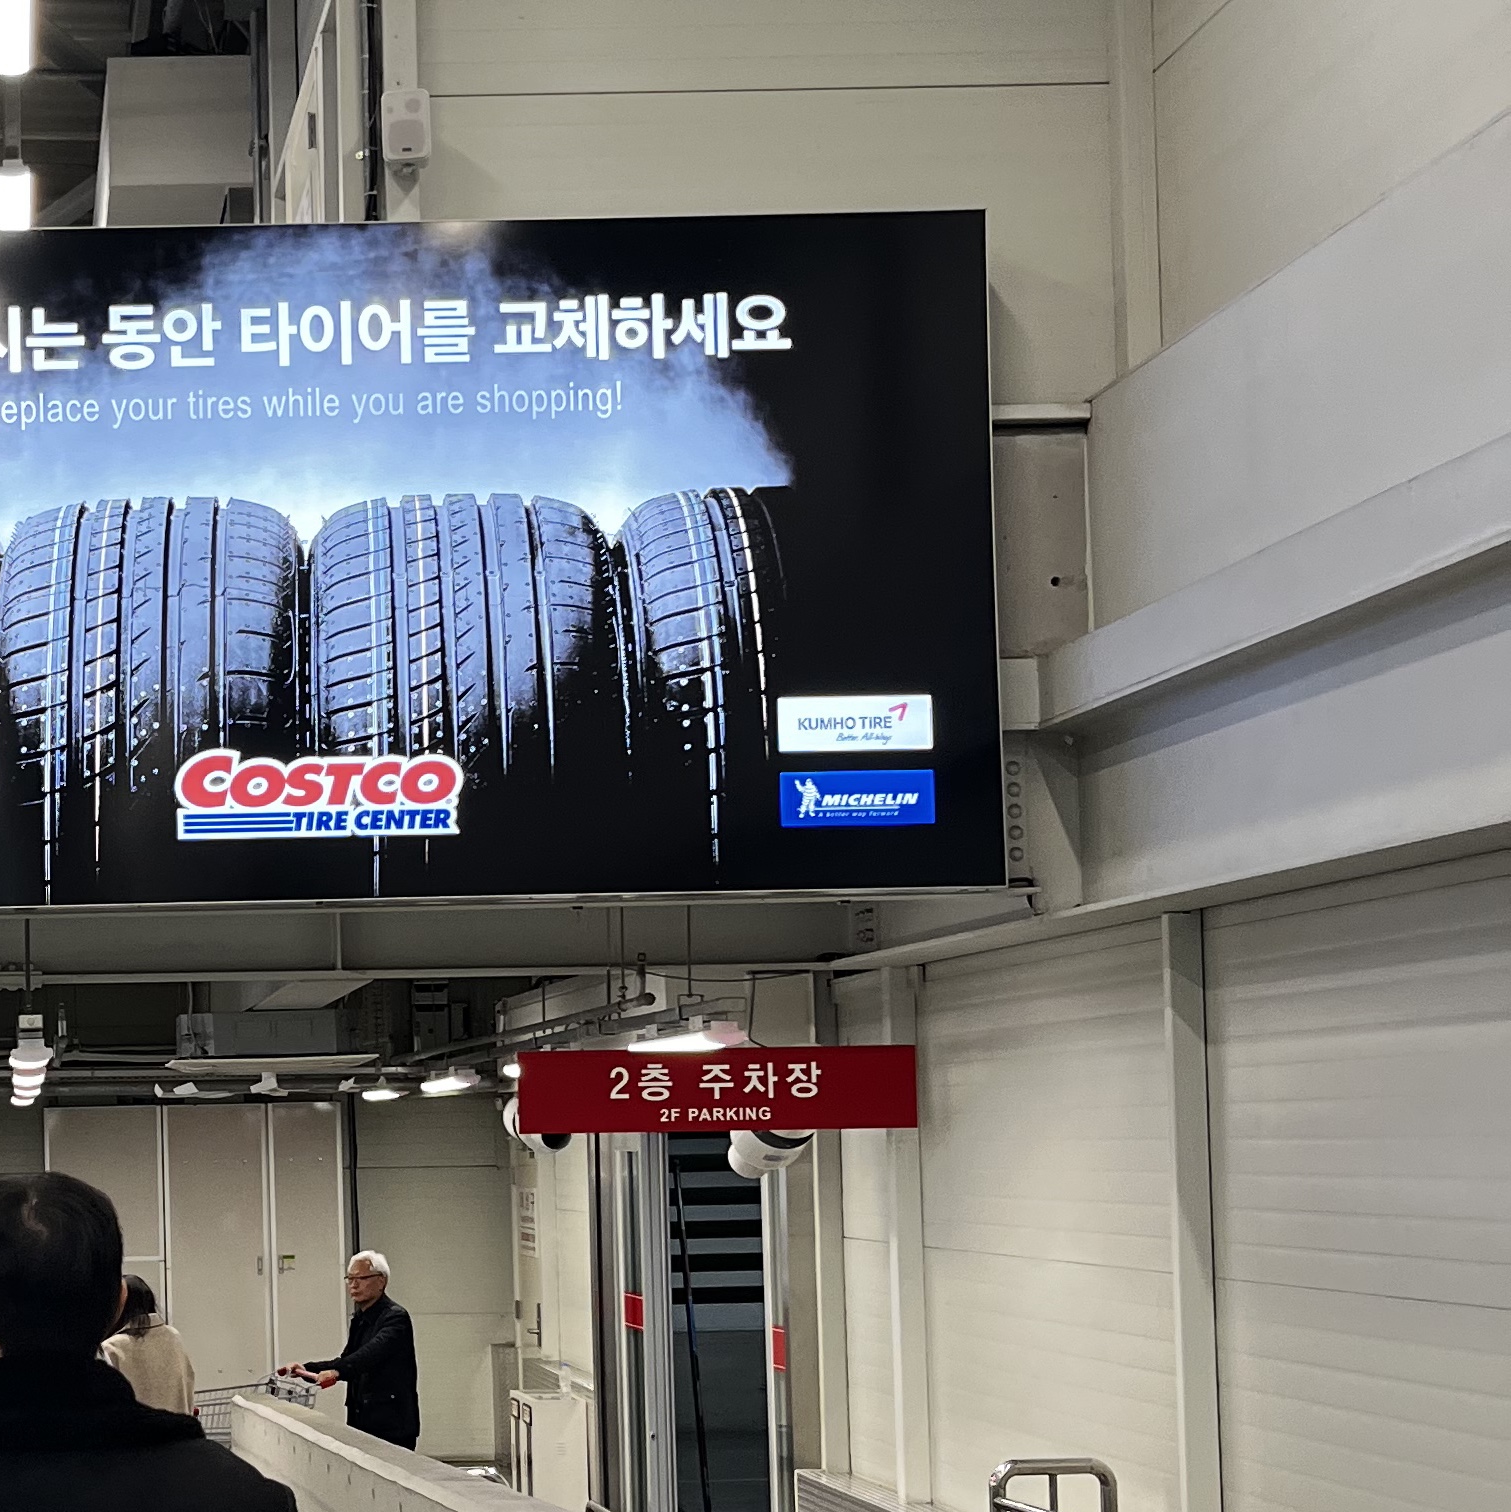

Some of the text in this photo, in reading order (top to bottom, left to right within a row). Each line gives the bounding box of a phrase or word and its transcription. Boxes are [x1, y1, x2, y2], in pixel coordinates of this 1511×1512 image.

[102, 302, 222, 371] 동안
[241, 299, 476, 367] 타이어를
[493, 292, 793, 361] 교체하세요
[111, 396, 177, 429] your
[187, 390, 252, 420] tires
[263, 386, 340, 418] while
[351, 391, 404, 424] you
[417, 389, 464, 415] are
[476, 380, 623, 420] shopping!
[797, 715, 893, 731] KUMHO TIRE
[180, 753, 458, 809] COSTCO
[821, 792, 920, 807] MICHELIN
[291, 808, 451, 832] TIRE CENTER
[609, 1061, 822, 1102] 2층 주차장
[659, 1106, 773, 1123] 2F PARKING
